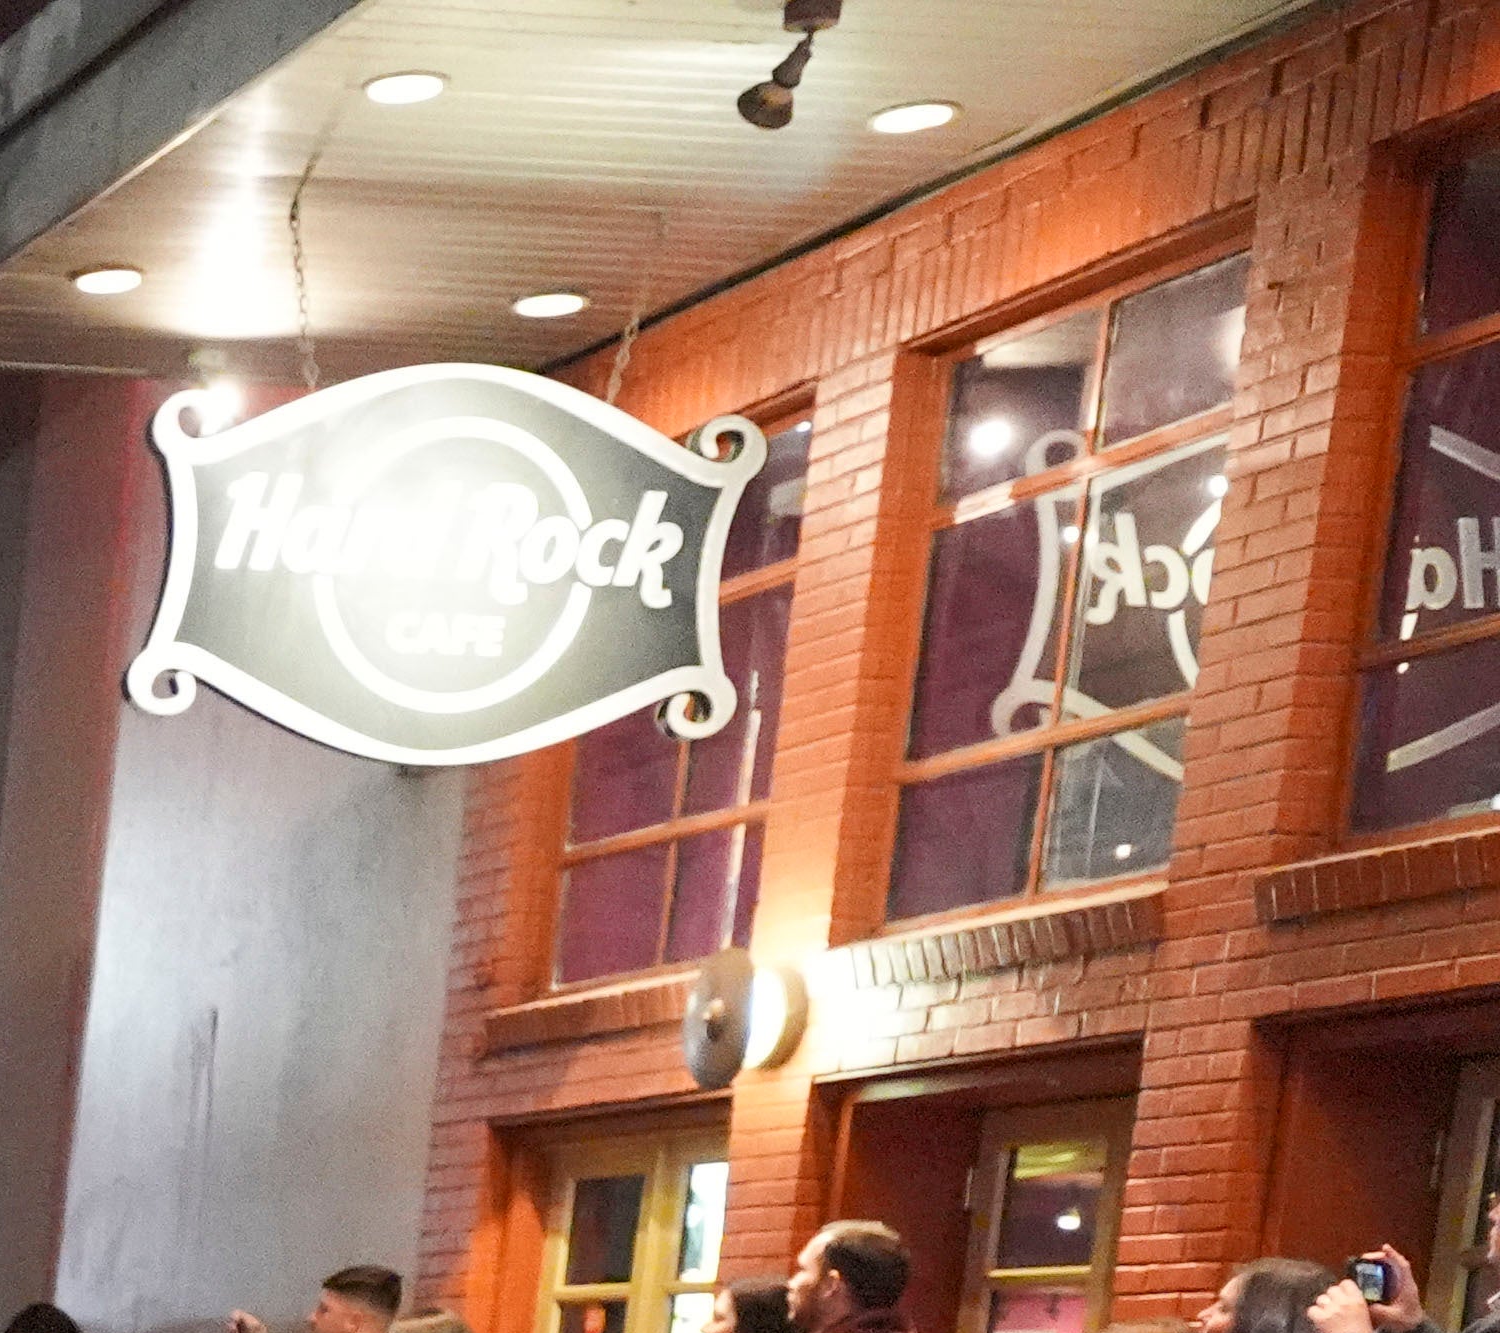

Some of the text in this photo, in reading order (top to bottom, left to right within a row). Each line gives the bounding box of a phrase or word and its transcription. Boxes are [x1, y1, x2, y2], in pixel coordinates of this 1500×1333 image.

[213, 470, 684, 609] Hard Rock
[387, 611, 507, 657] CAFE
